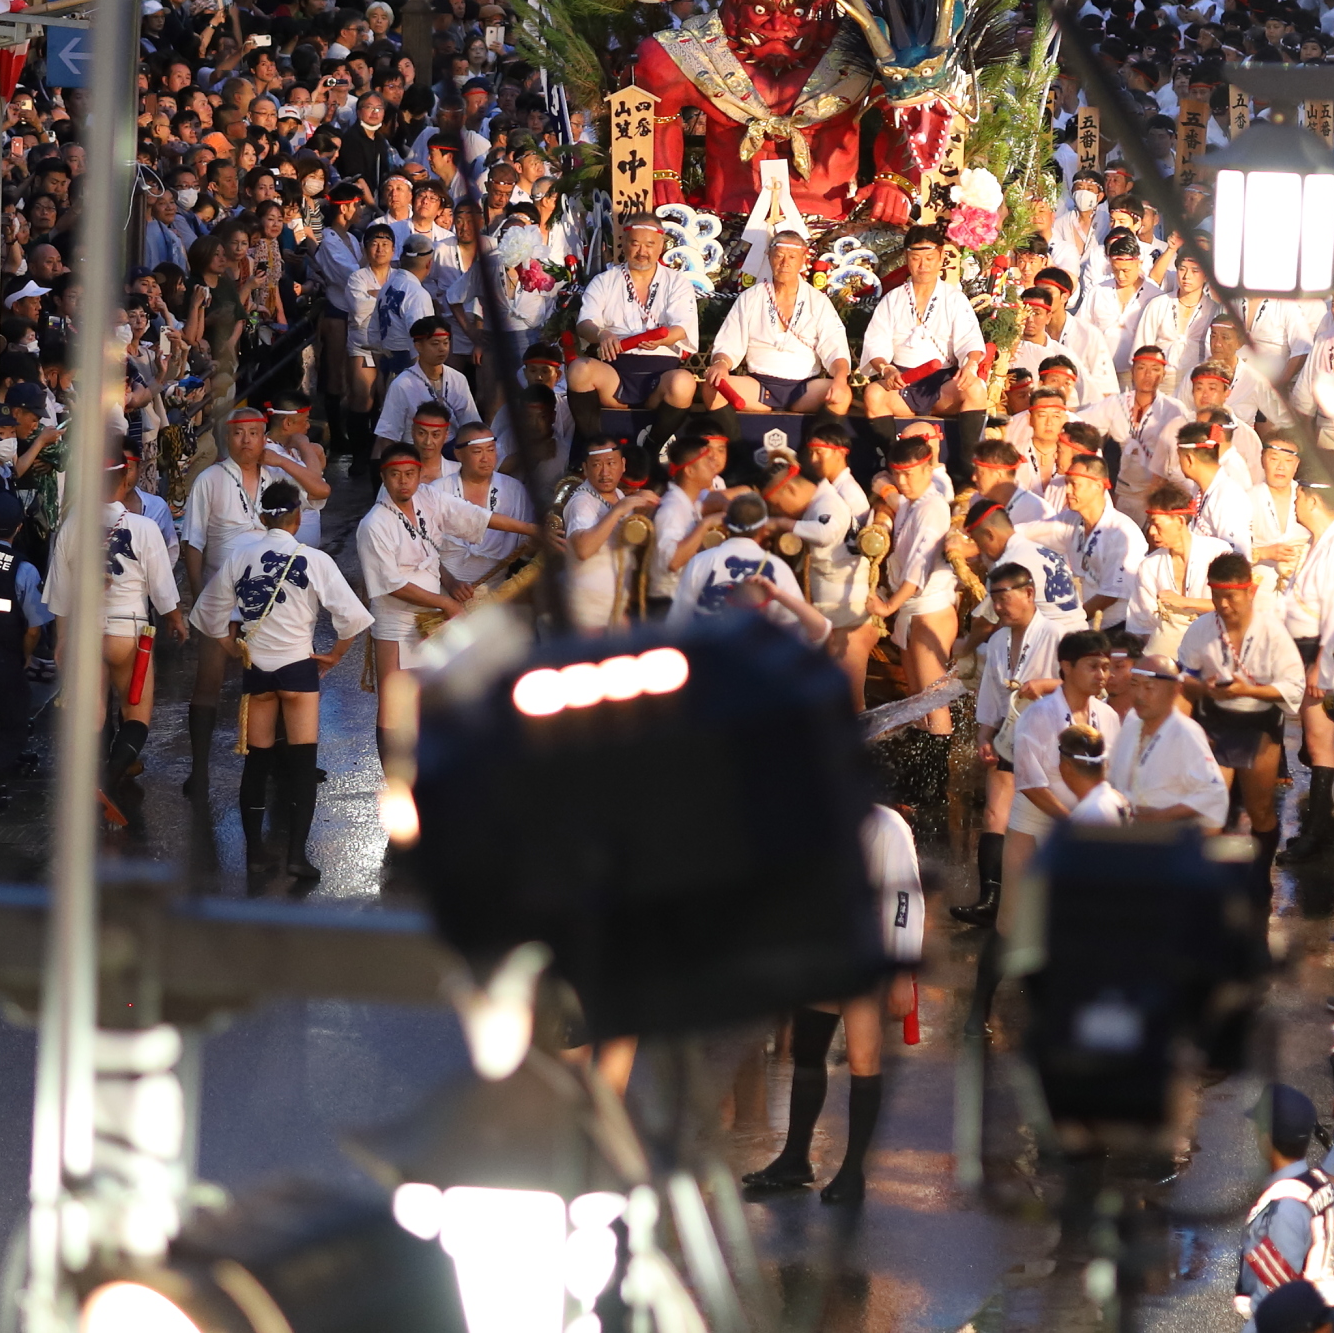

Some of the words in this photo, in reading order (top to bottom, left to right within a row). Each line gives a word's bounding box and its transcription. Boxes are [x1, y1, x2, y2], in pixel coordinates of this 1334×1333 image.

[615, 100, 633, 141] 山笠
[635, 101, 653, 138] 四番
[1233, 93, 1248, 130] 五番
[617, 149, 649, 263] 中洲
